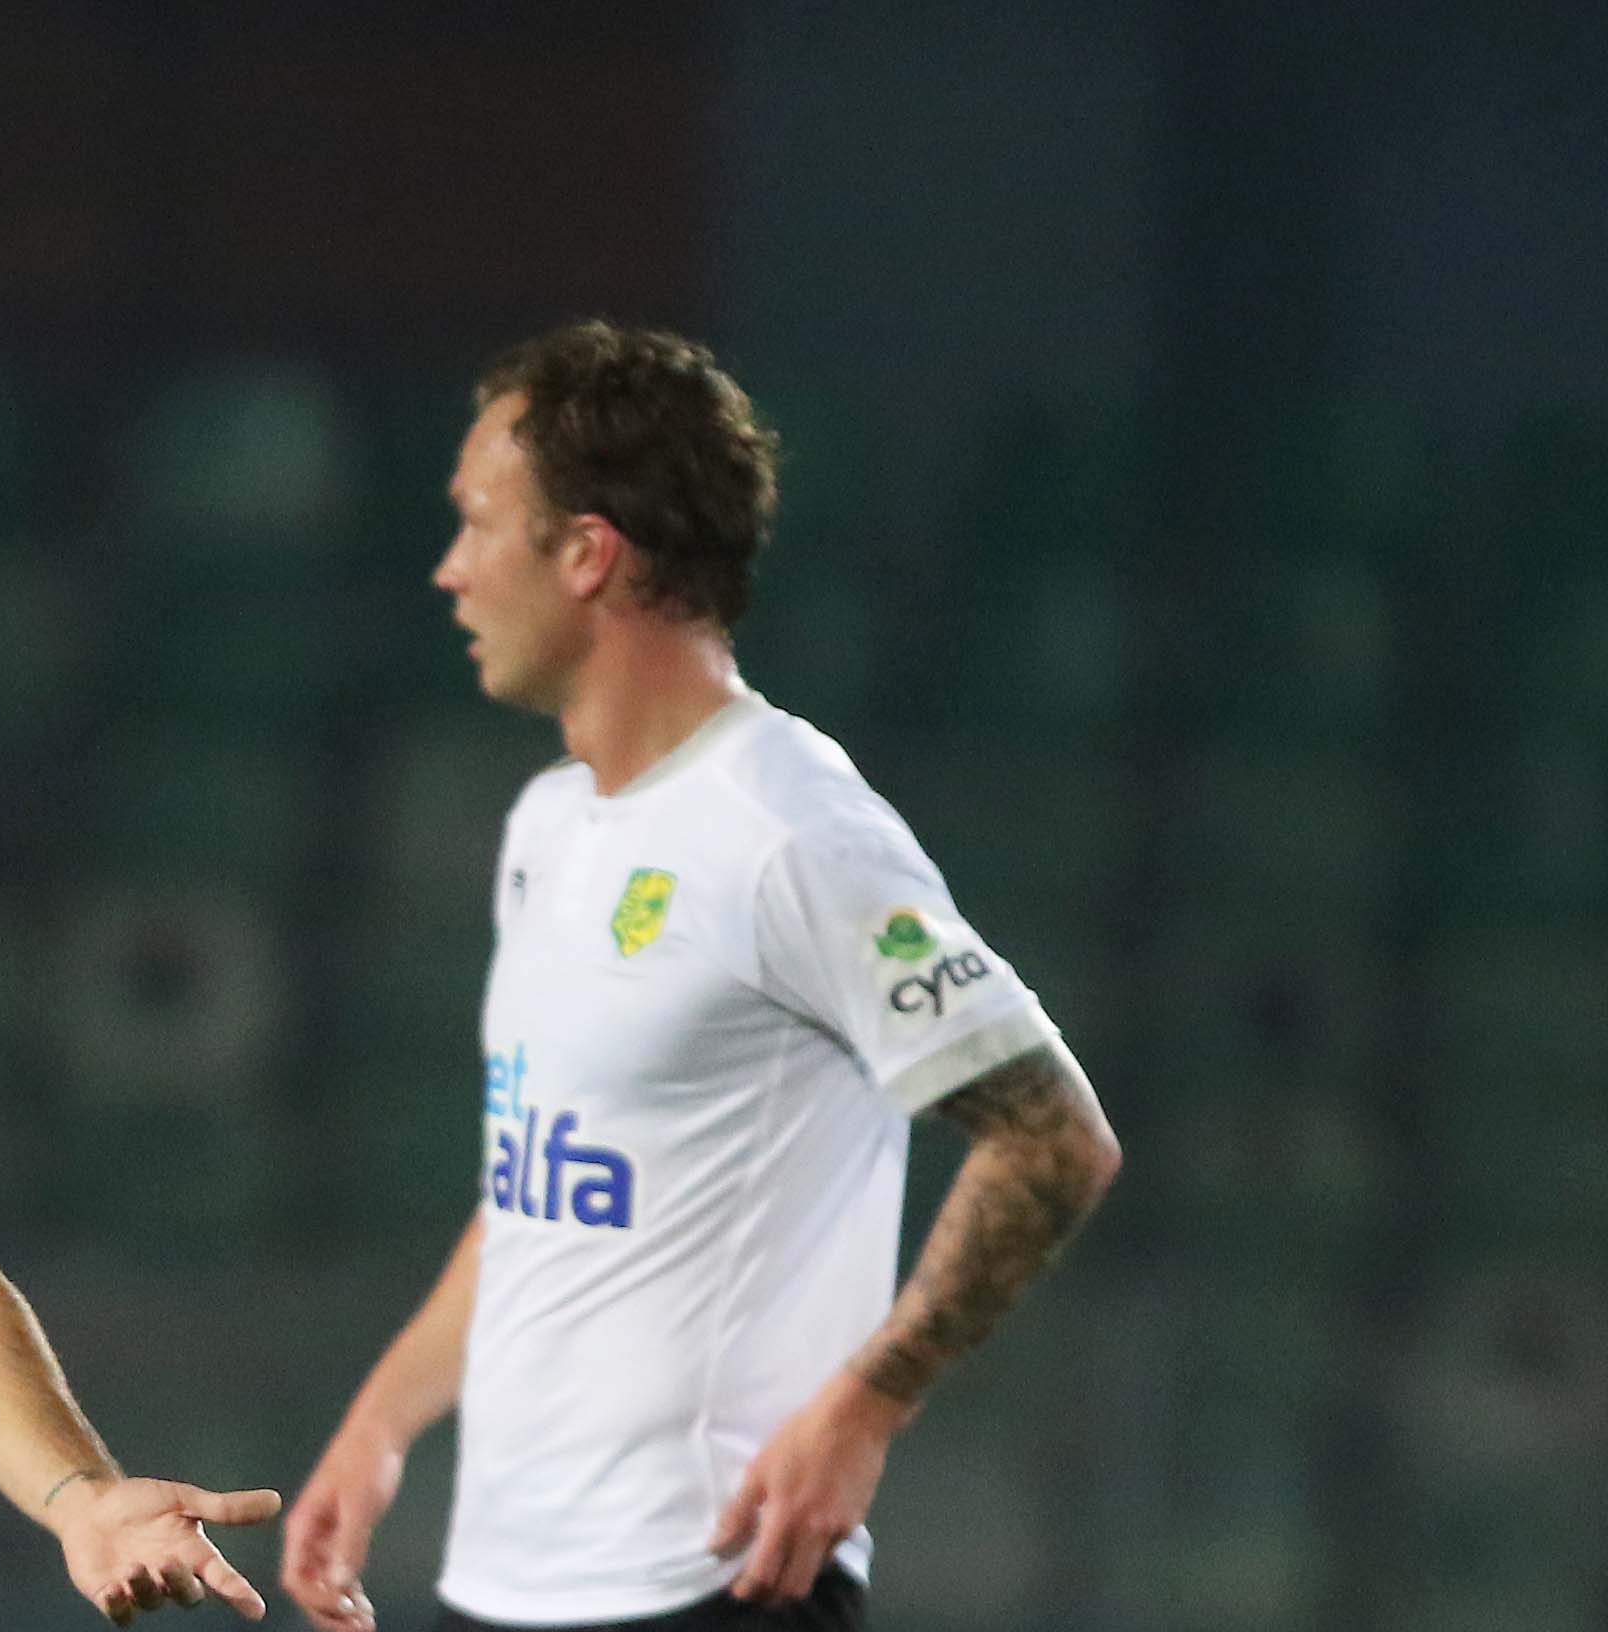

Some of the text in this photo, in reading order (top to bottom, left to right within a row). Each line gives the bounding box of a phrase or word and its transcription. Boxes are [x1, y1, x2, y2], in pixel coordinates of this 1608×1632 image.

[891, 950, 989, 1017] cyta
[486, 1044, 527, 1120] et
[494, 1106, 634, 1229] alfa
